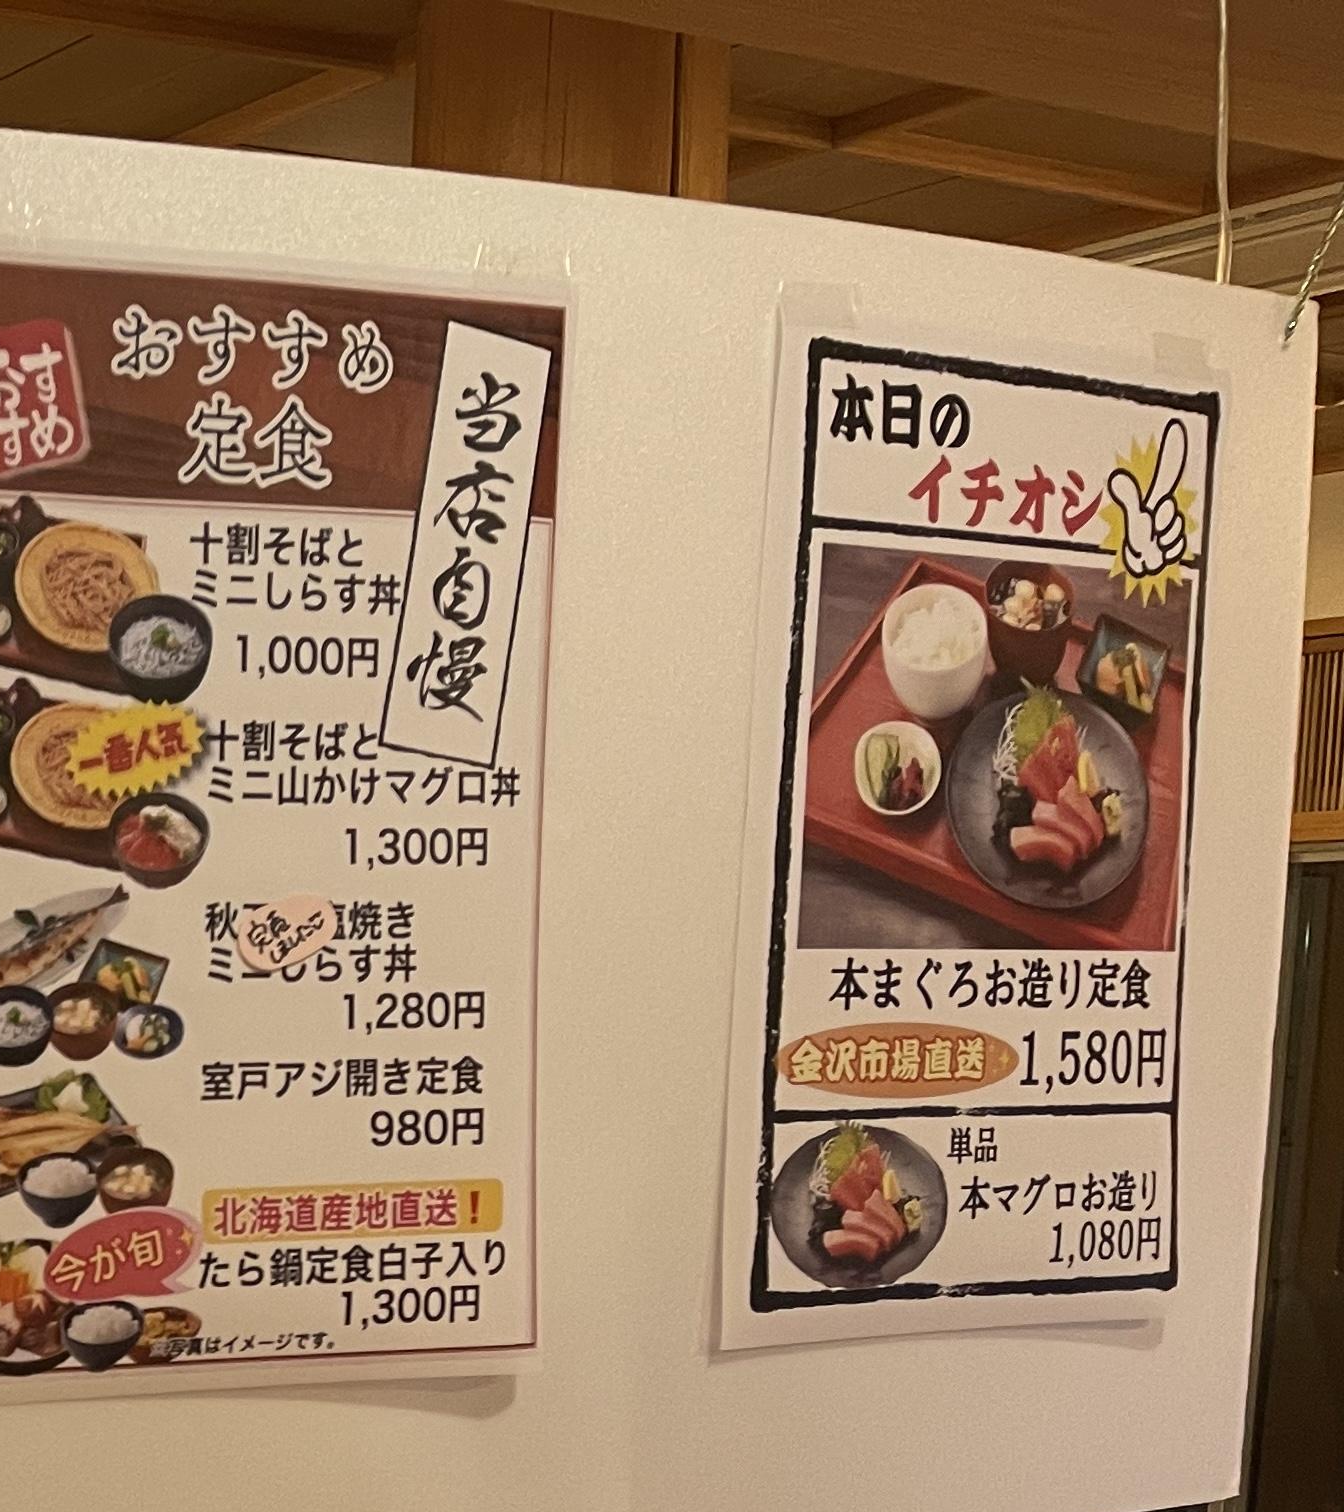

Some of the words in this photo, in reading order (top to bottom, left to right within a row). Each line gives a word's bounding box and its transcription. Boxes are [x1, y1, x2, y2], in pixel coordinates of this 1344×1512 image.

[112, 305, 394, 394] おすすめ
[829, 373, 972, 449] 本日の
[178, 392, 333, 488] 定食
[908, 454, 1104, 536] イチオシ
[189, 522, 365, 568] 十割そばと
[407, 370, 523, 723] 当店自慢
[189, 571, 404, 617] ミニしらす丼
[235, 634, 381, 680] 1,000円
[205, 719, 380, 762] 十割そばと
[207, 765, 522, 808] ミニ山かけマグロ丼
[344, 826, 490, 870] 1,300円
[829, 956, 1152, 1011] 本まぐろお造り定食
[343, 990, 487, 1036] 1,280円
[200, 1055, 485, 1102] 室戸アジ開き定食
[789, 1036, 987, 1085] 金沢市場直送
[1018, 1027, 1168, 1094] 1,580円
[368, 1107, 486, 1149] 980円
[947, 1126, 999, 1164] 単品
[958, 1169, 1159, 1220] 本マグロお造り
[48, 1228, 165, 1294] 今が旬
[197, 1240, 507, 1290] たら鍋定食白子入り
[1048, 1216, 1162, 1268] 1,080円
[339, 1285, 481, 1328] 1,300円
